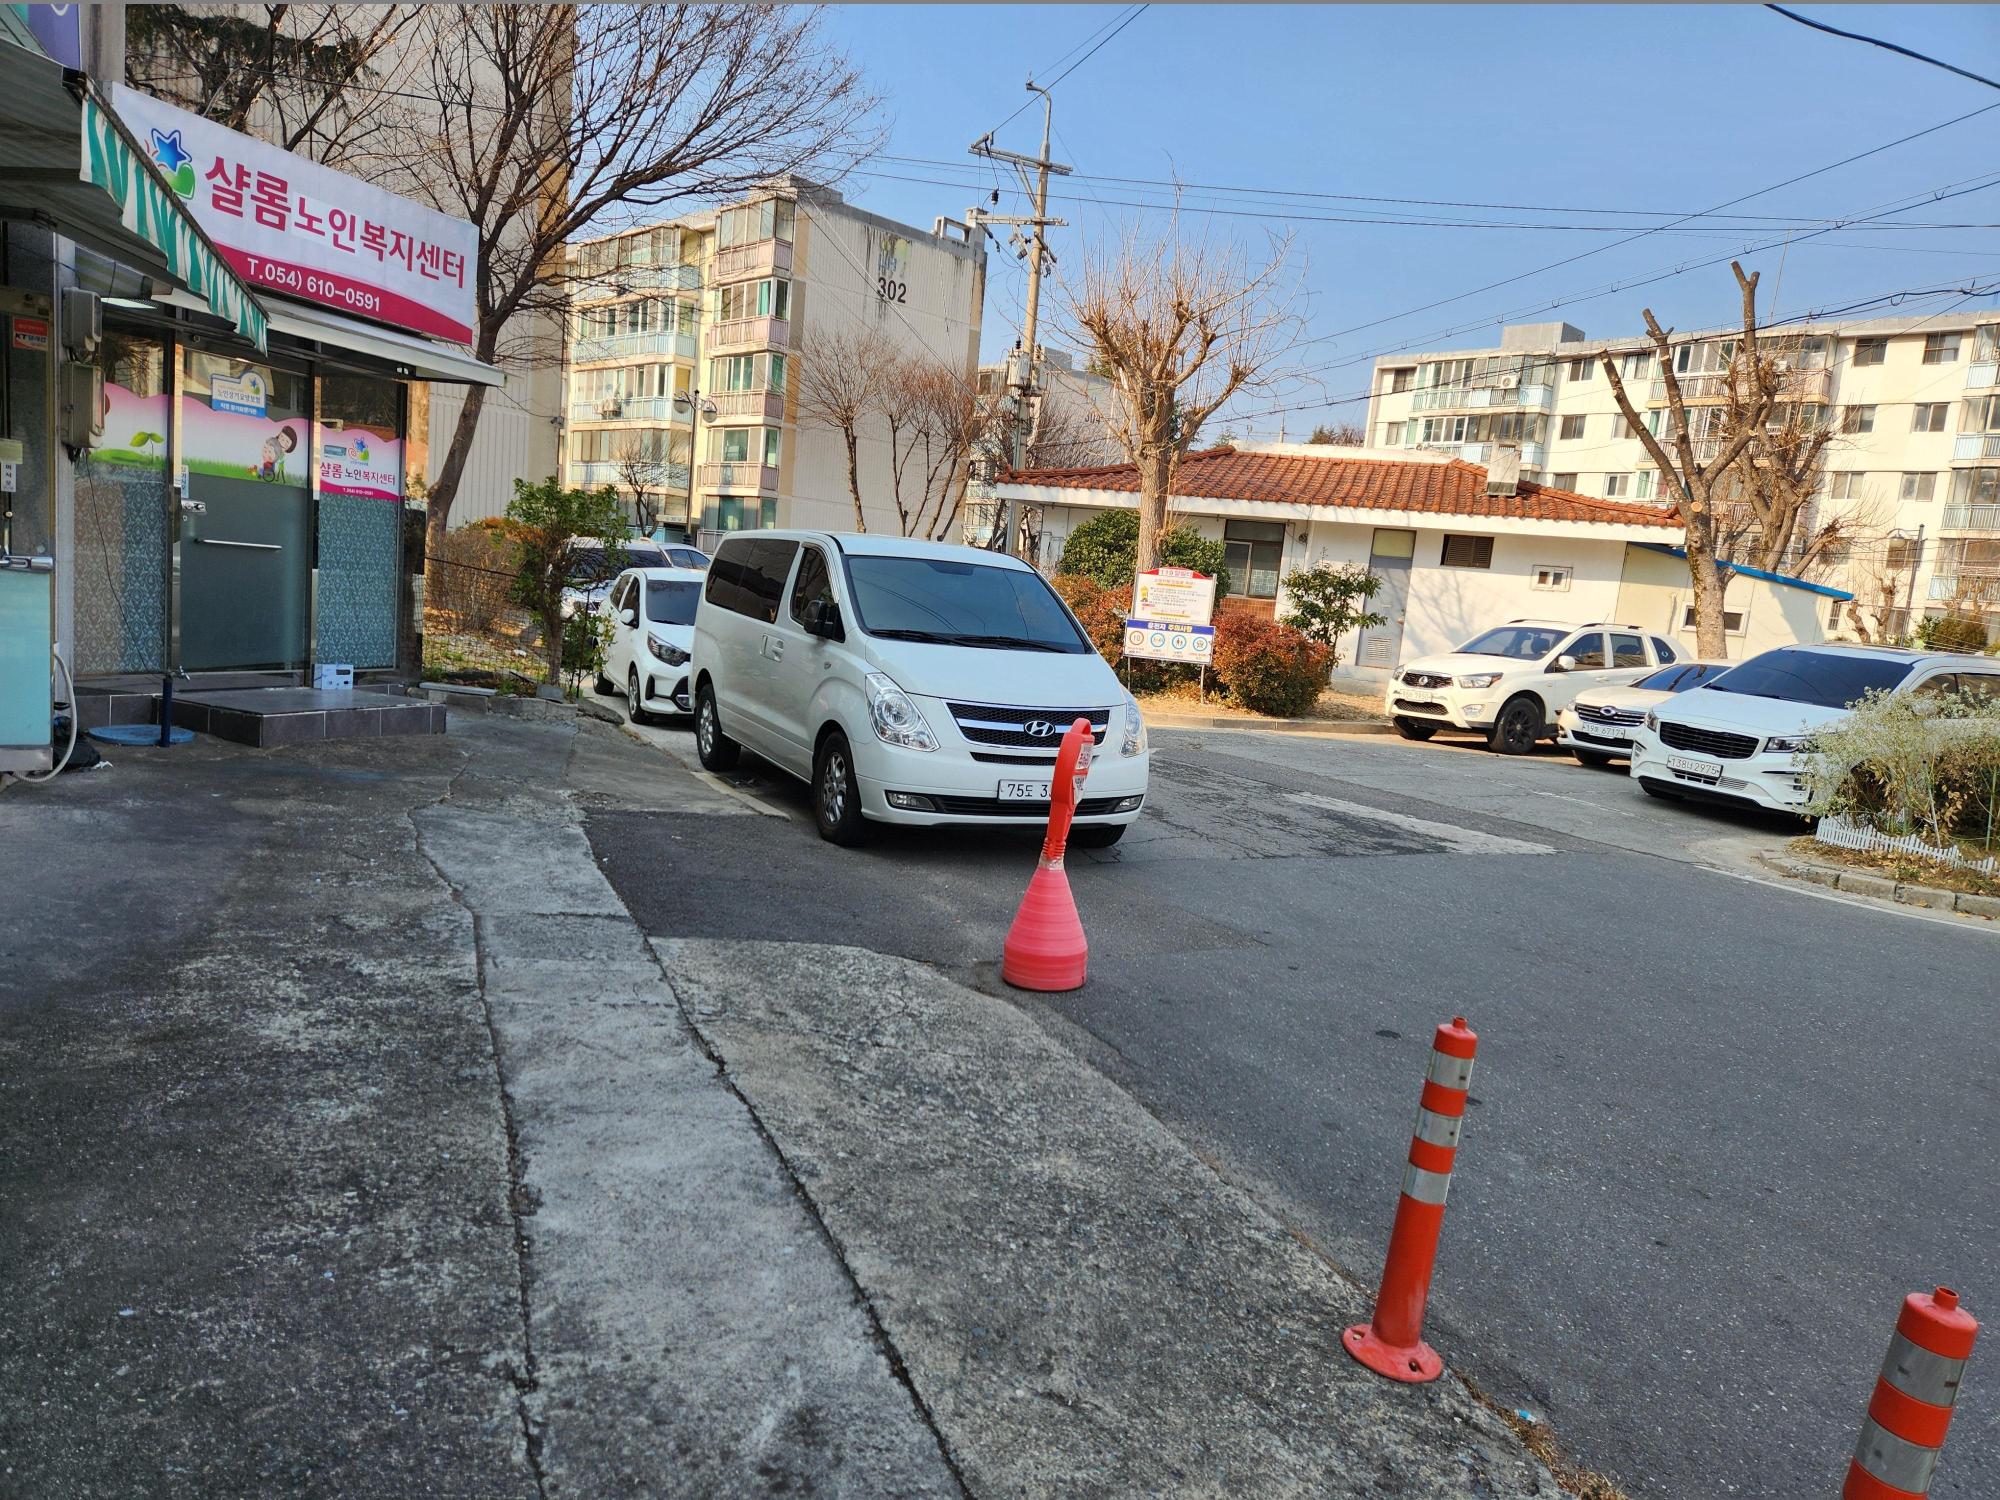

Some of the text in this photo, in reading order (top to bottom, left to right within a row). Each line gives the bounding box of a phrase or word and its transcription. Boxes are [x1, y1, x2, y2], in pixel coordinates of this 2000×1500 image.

[247, 257, 381, 312] T.054) 610-0591
[877, 276, 907, 304] 302
[320, 461, 395, 485] 샬롬 노인복지센터
[1601, 728, 1621, 737] 6717
[1694, 762, 1717, 775] 2975
[1007, 783, 1053, 798] 75도 3
